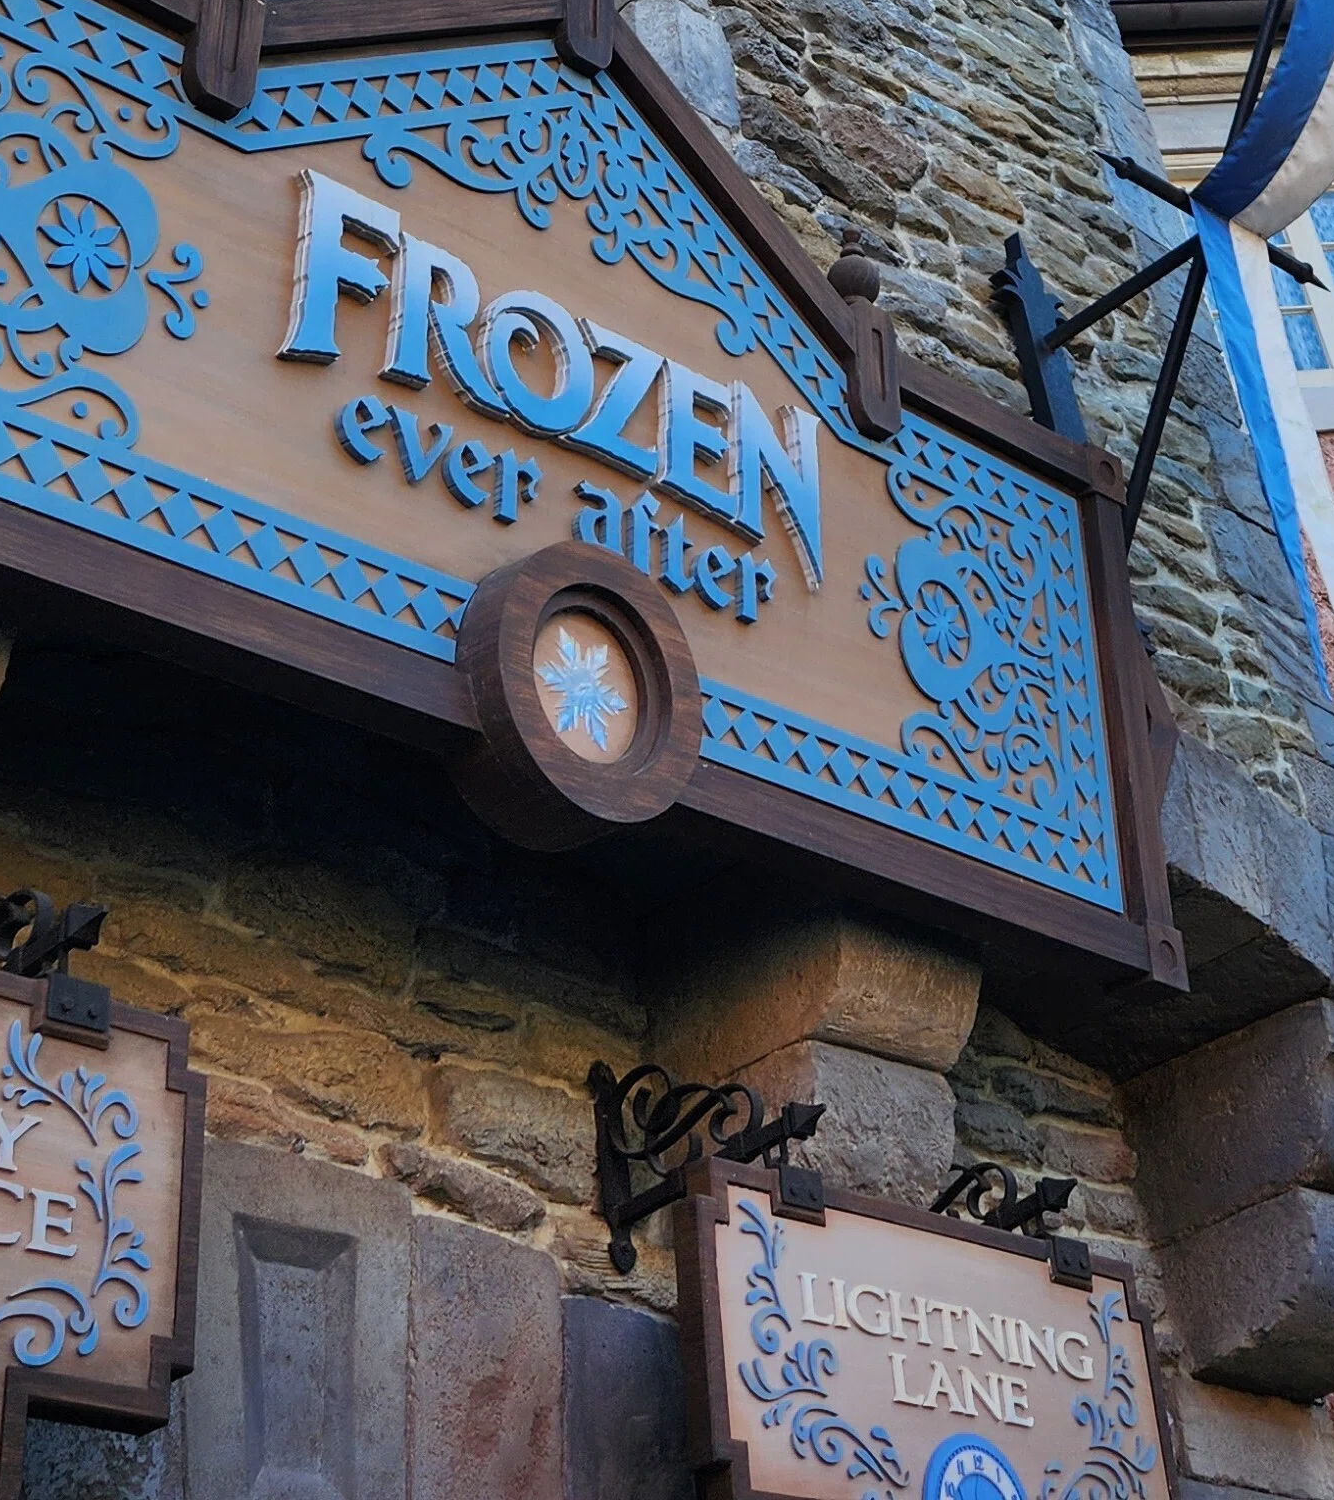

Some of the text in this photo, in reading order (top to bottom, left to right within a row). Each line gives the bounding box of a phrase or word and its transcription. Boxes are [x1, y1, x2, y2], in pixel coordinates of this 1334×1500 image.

[276, 167, 822, 596] FROZEN
[334, 395, 775, 625] ever after
[798, 1271, 1096, 1381] LIGHTNING
[888, 1351, 1036, 1428] LANE
